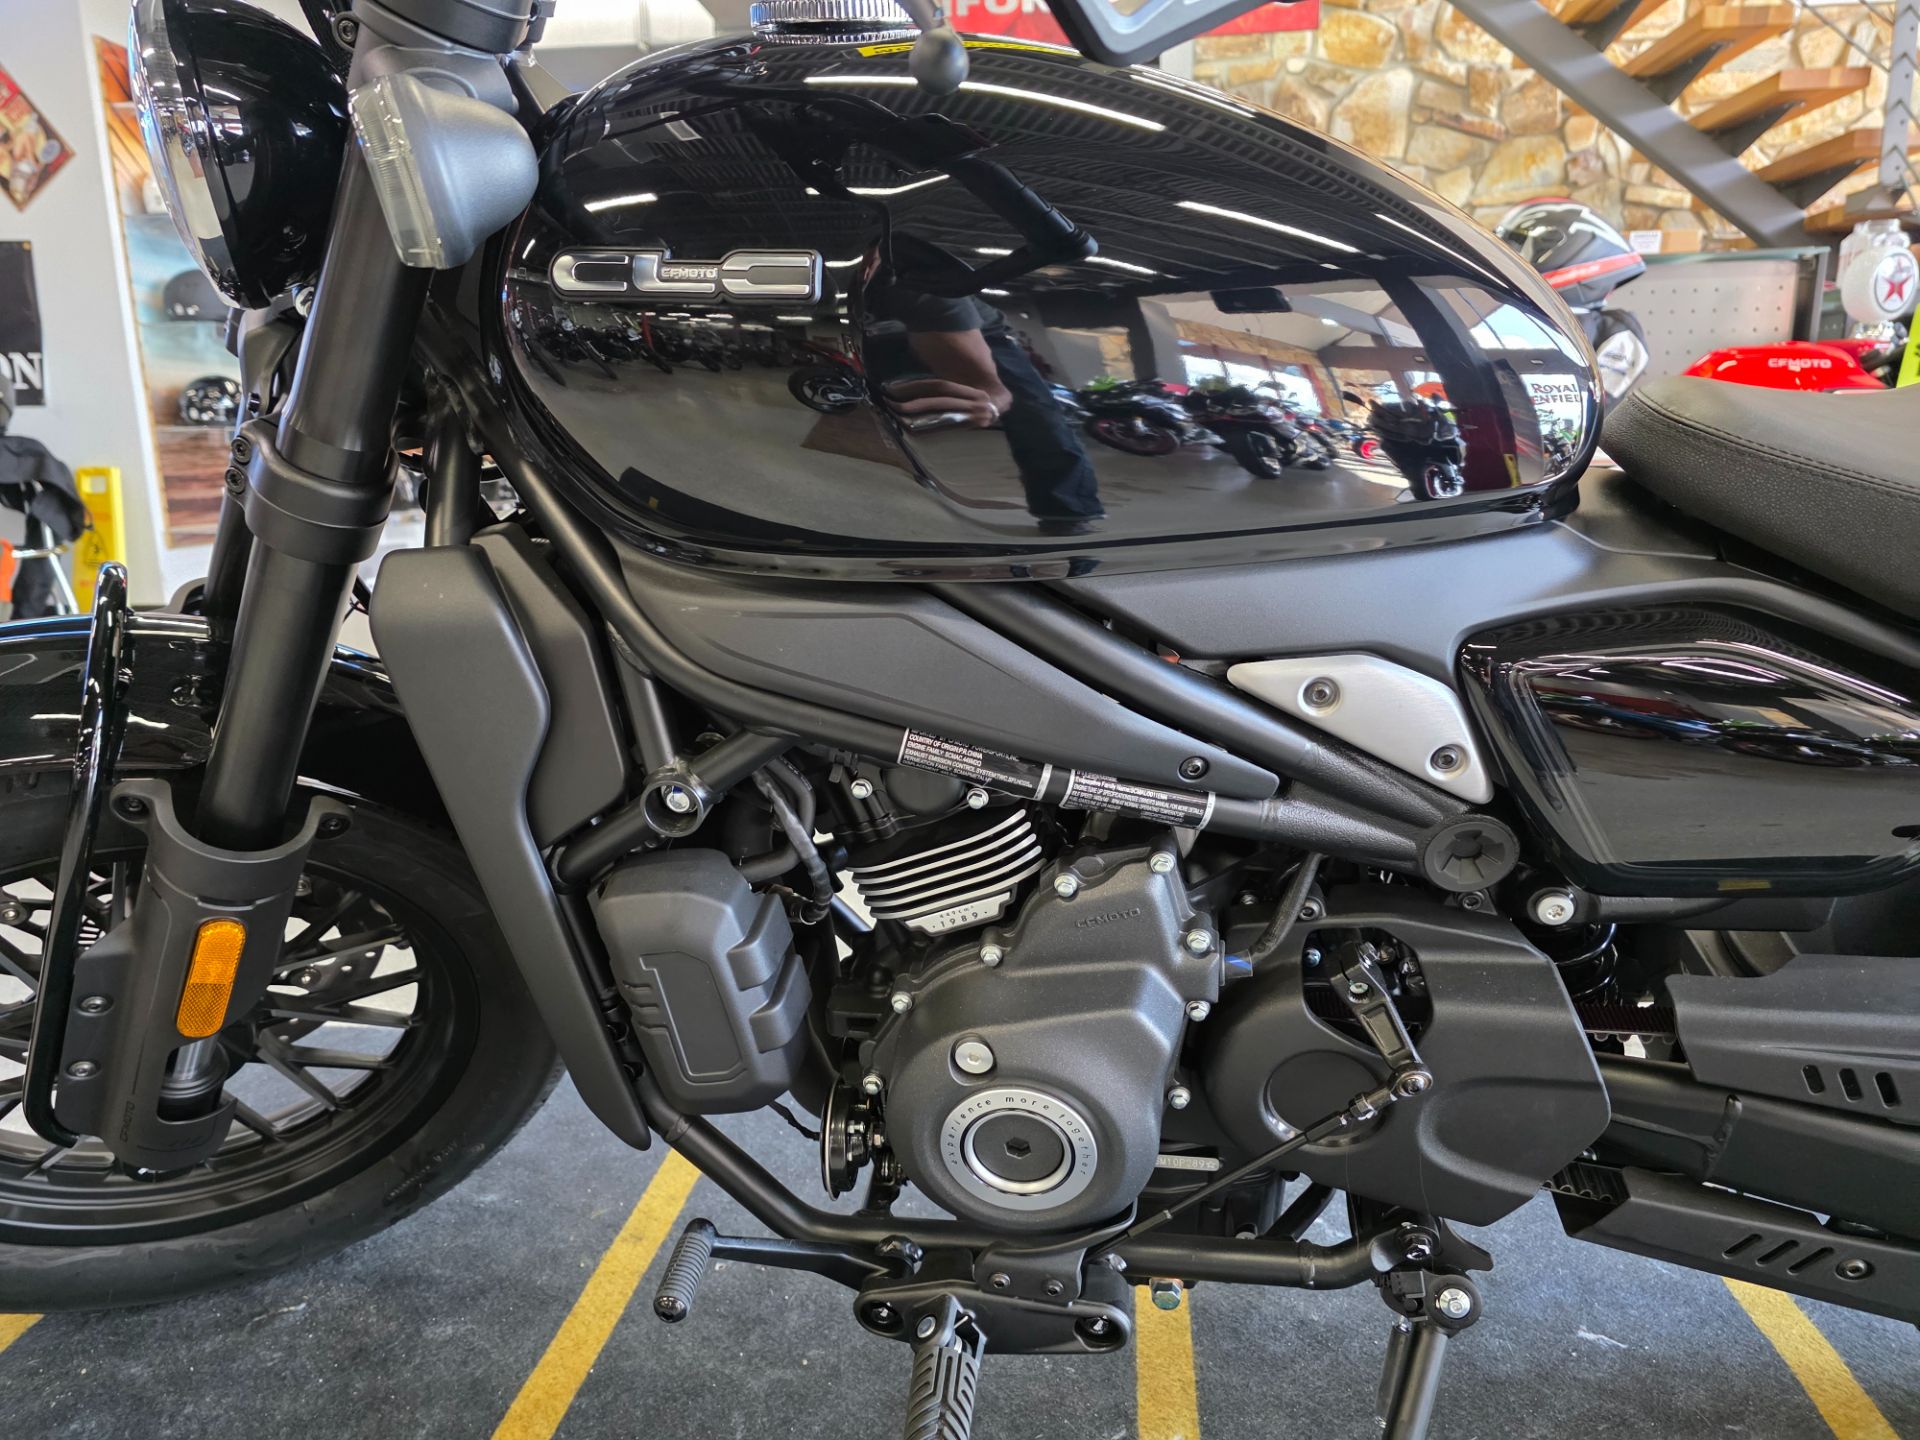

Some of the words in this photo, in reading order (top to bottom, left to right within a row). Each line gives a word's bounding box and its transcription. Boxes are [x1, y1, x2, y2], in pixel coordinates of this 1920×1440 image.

[661, 266, 718, 279] CFMOTO
[1767, 357, 1832, 369] CFMOTO
[908, 734, 934, 745] COUNTRY
[907, 741, 926, 752] ENGINE
[952, 759, 977, 773] CONTROL
[941, 912, 978, 928] 1989
[1075, 907, 1140, 928] CFMOTO
[947, 1099, 992, 1166] experience
[1005, 1096, 1050, 1110] more
[1058, 1113, 1091, 1176] together
